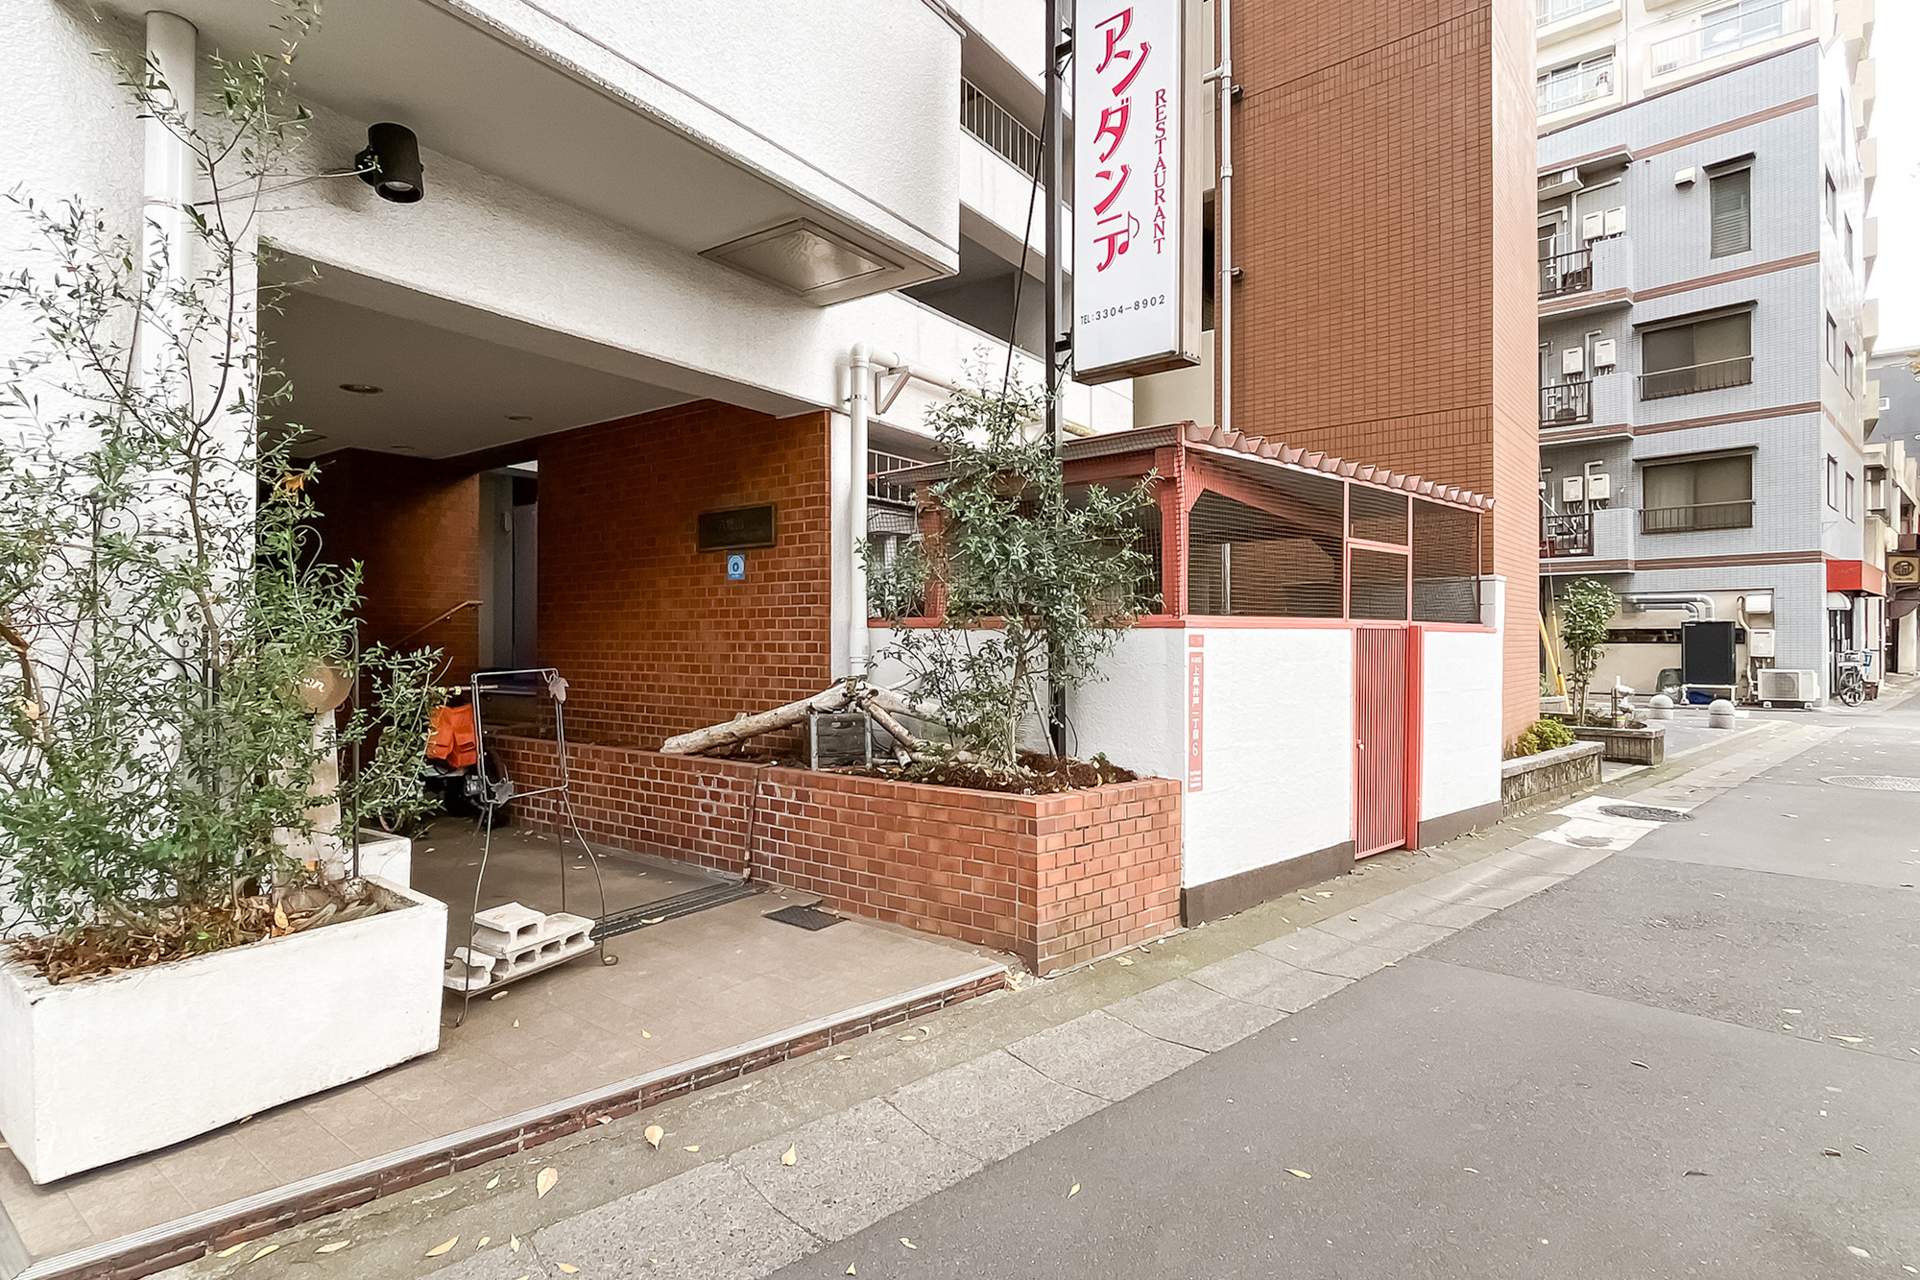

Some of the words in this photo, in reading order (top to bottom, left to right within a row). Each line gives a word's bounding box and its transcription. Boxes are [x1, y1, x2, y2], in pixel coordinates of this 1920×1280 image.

[1093, 6, 1152, 273] アンダンテ
[1152, 88, 1168, 255] RESTAURANT
